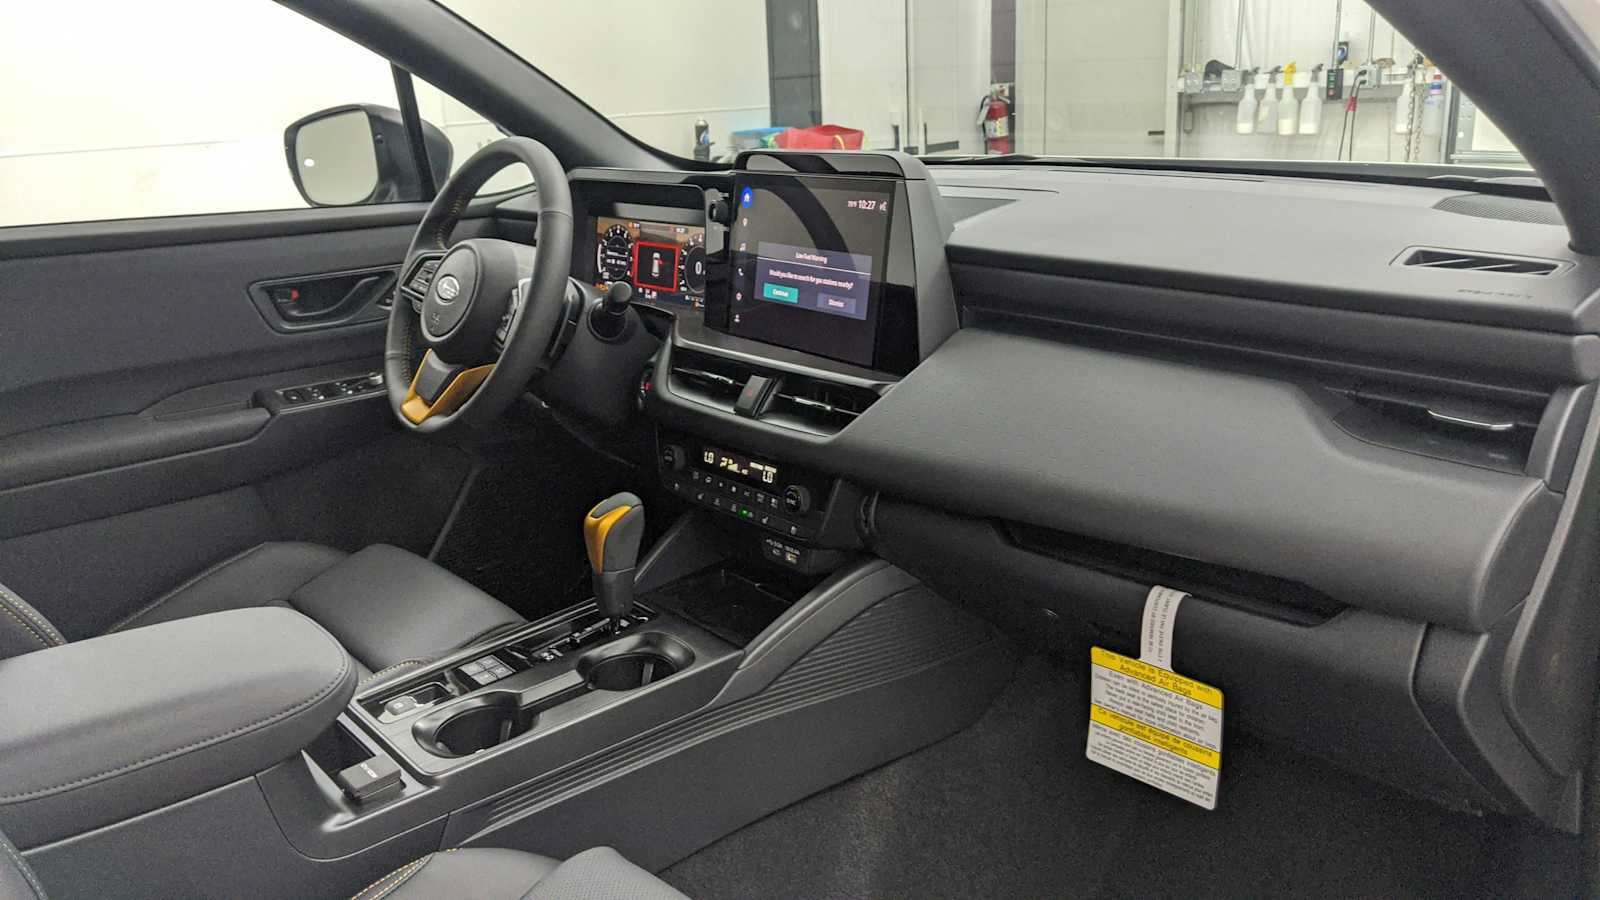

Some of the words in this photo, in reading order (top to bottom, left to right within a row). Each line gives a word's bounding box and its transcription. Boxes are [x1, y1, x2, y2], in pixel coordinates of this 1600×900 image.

[859, 200, 876, 210] 10:27
[1119, 664, 1156, 682] Advanced
[1159, 678, 1168, 687] Air
[1172, 682, 1192, 697] Bags
